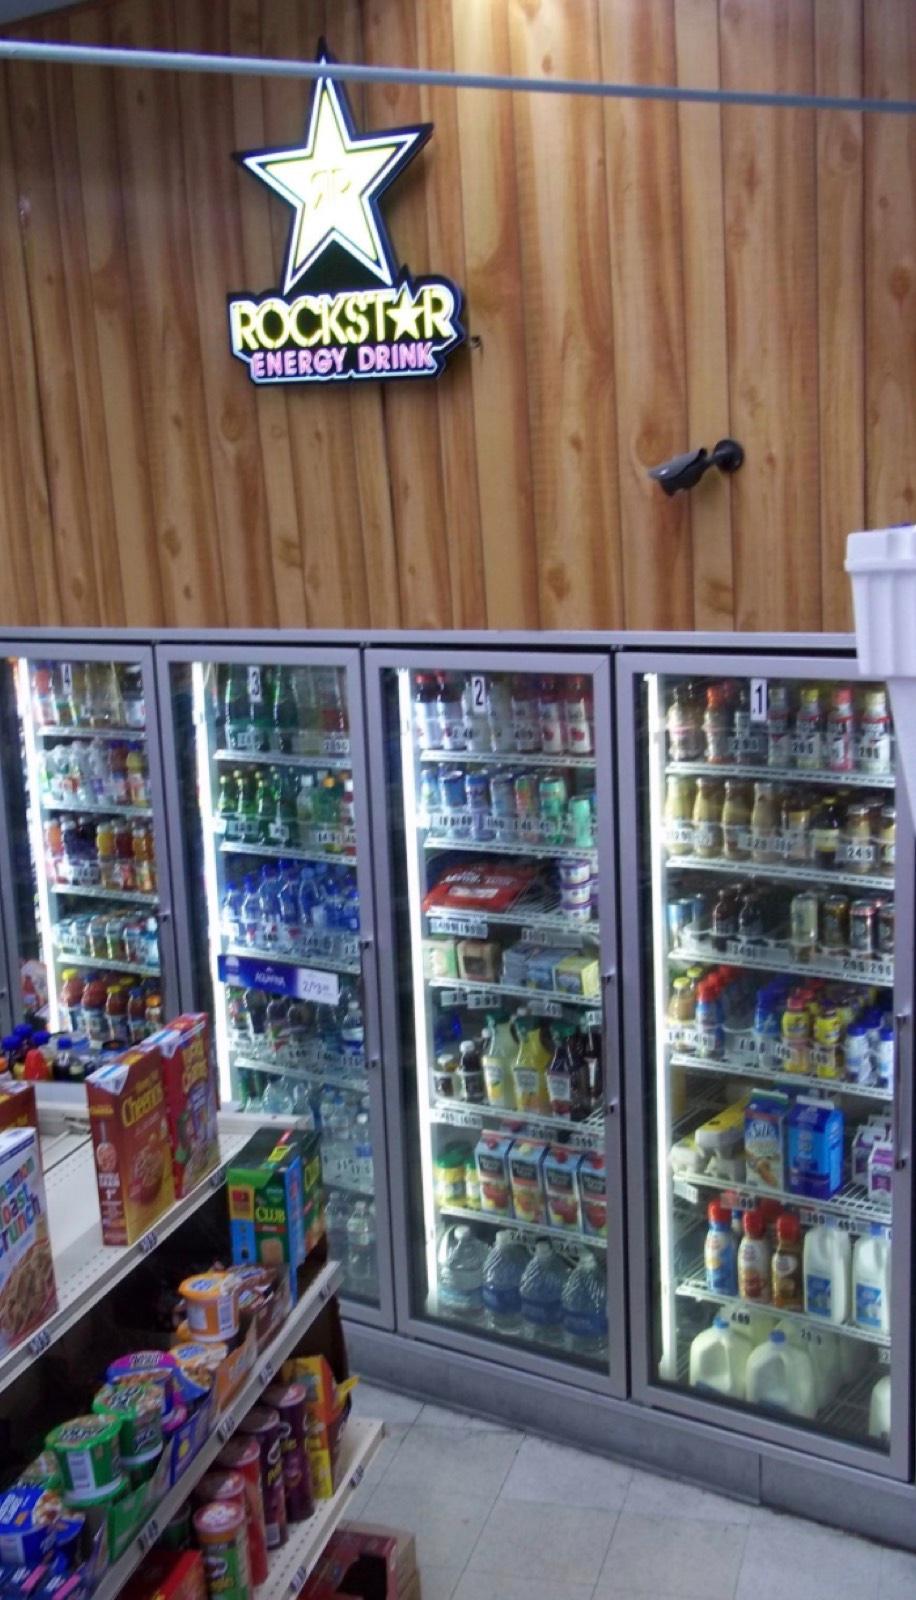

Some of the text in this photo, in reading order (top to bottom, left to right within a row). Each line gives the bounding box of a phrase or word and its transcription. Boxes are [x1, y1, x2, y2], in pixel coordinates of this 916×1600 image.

[231, 282, 456, 351] ROCKSTAR
[251, 341, 433, 378] ENERGY DRINK
[251, 671, 260, 696] 3
[475, 678, 485, 706] 2
[755, 685, 764, 715] 1
[749, 1118, 776, 1140] Silk
